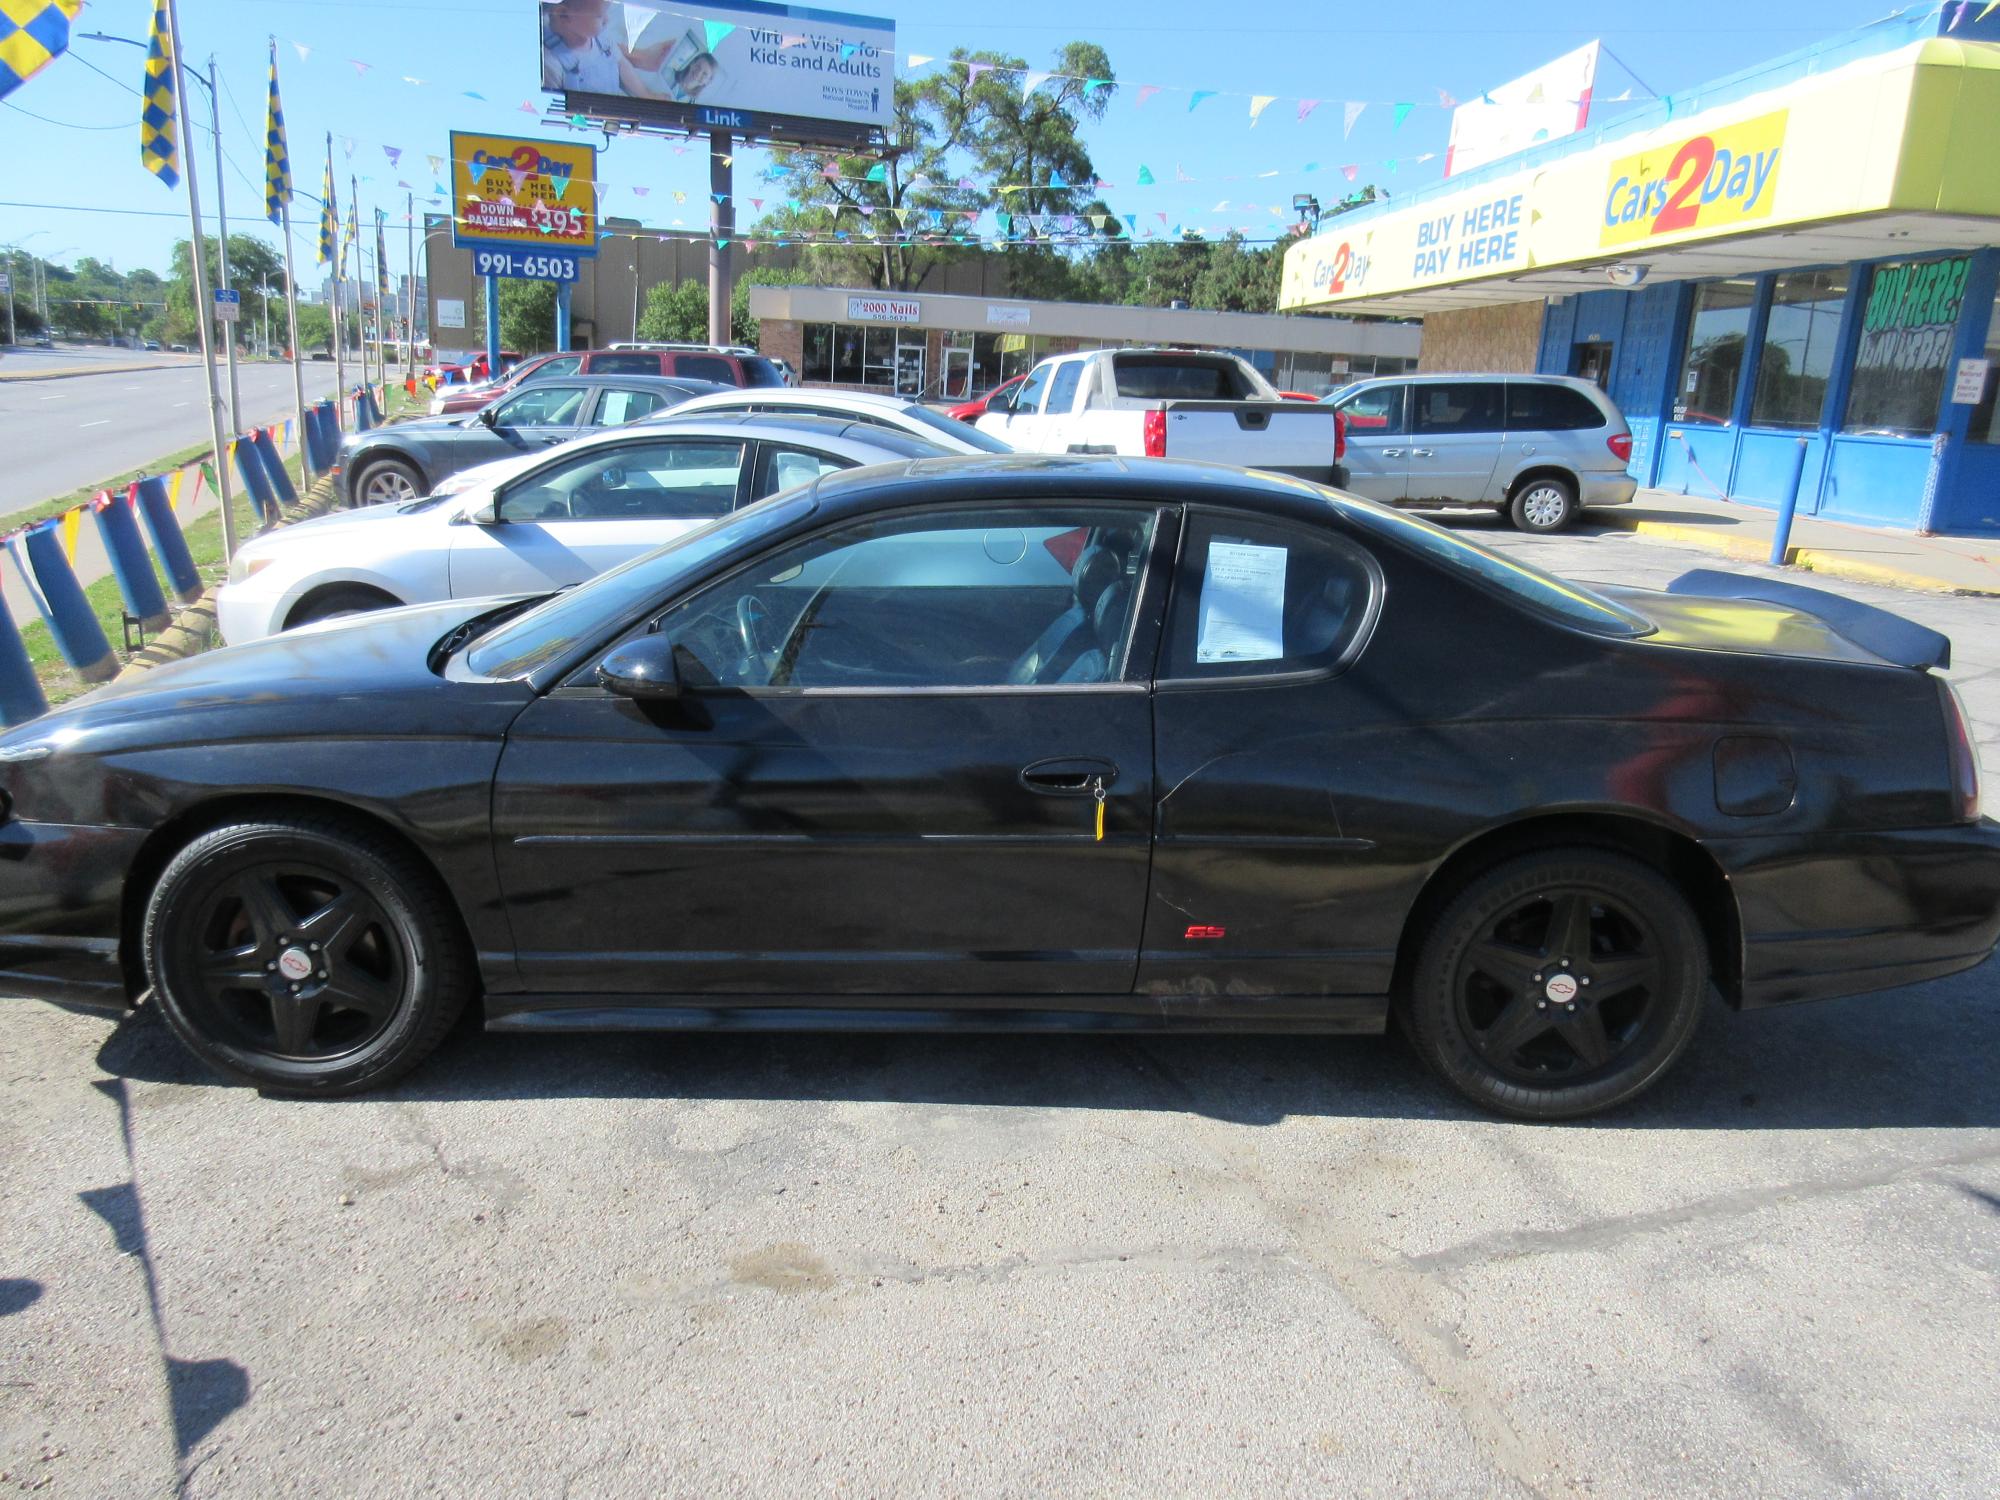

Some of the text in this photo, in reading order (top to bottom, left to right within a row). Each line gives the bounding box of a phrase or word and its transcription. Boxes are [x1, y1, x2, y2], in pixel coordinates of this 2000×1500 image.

[750, 28, 881, 58] Virtl Visi for
[750, 47, 881, 79] Kids and Adults
[846, 89, 870, 99] TOWN
[706, 110, 741, 127] Link
[486, 178, 565, 195] BUY HER
[486, 187, 565, 201] PAY HER
[480, 203, 514, 216] DOWN
[1417, 194, 1523, 248] BUY HERE
[1413, 230, 1518, 278] PAY HERE
[479, 252, 575, 279] 991-6503
[1864, 256, 1972, 333] BUY HERE!
[863, 302, 918, 316] 2000 Nails
